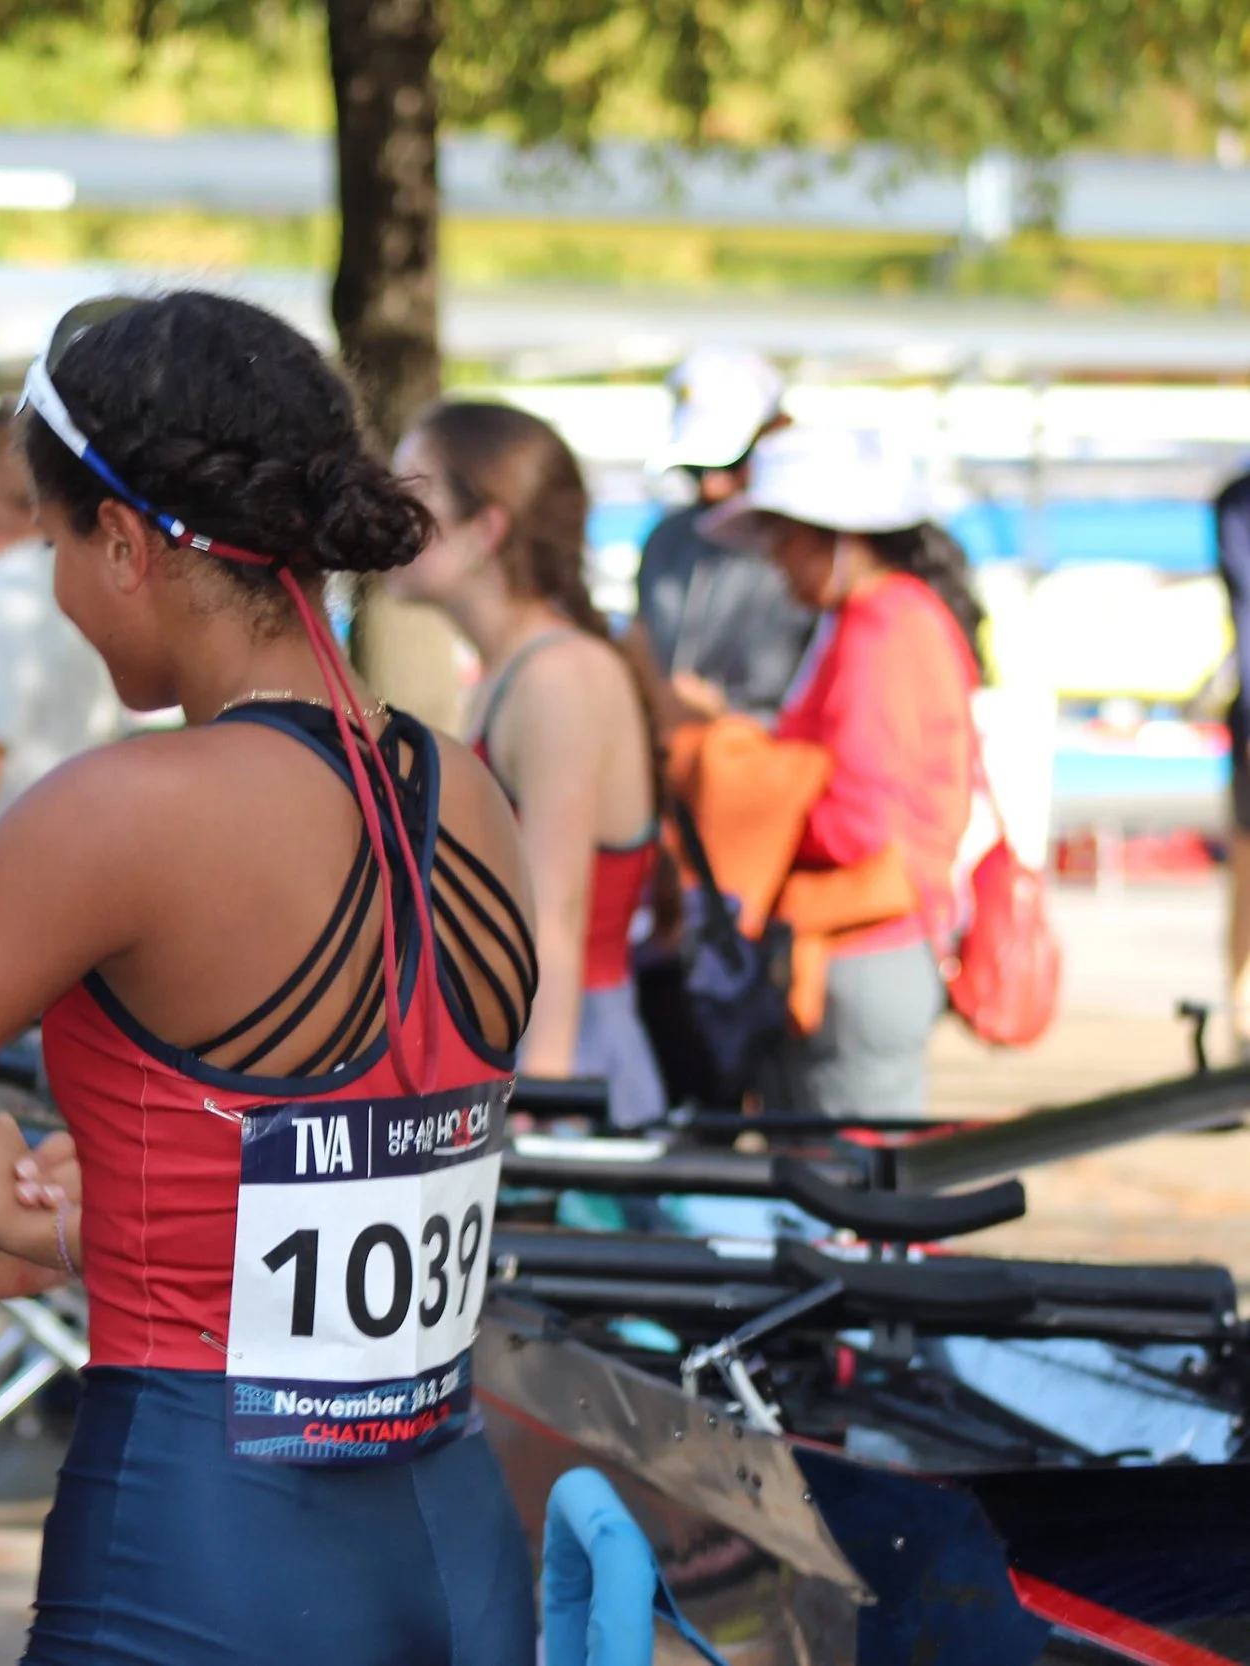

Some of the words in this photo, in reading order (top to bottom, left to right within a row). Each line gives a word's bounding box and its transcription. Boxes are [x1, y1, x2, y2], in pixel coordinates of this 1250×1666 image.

[291, 1114, 354, 1176] TVA
[388, 1139, 409, 1157] OF
[261, 1202, 483, 1339] 1039
[274, 1389, 407, 1419] November
[303, 1408, 438, 1445] CHATTAN
